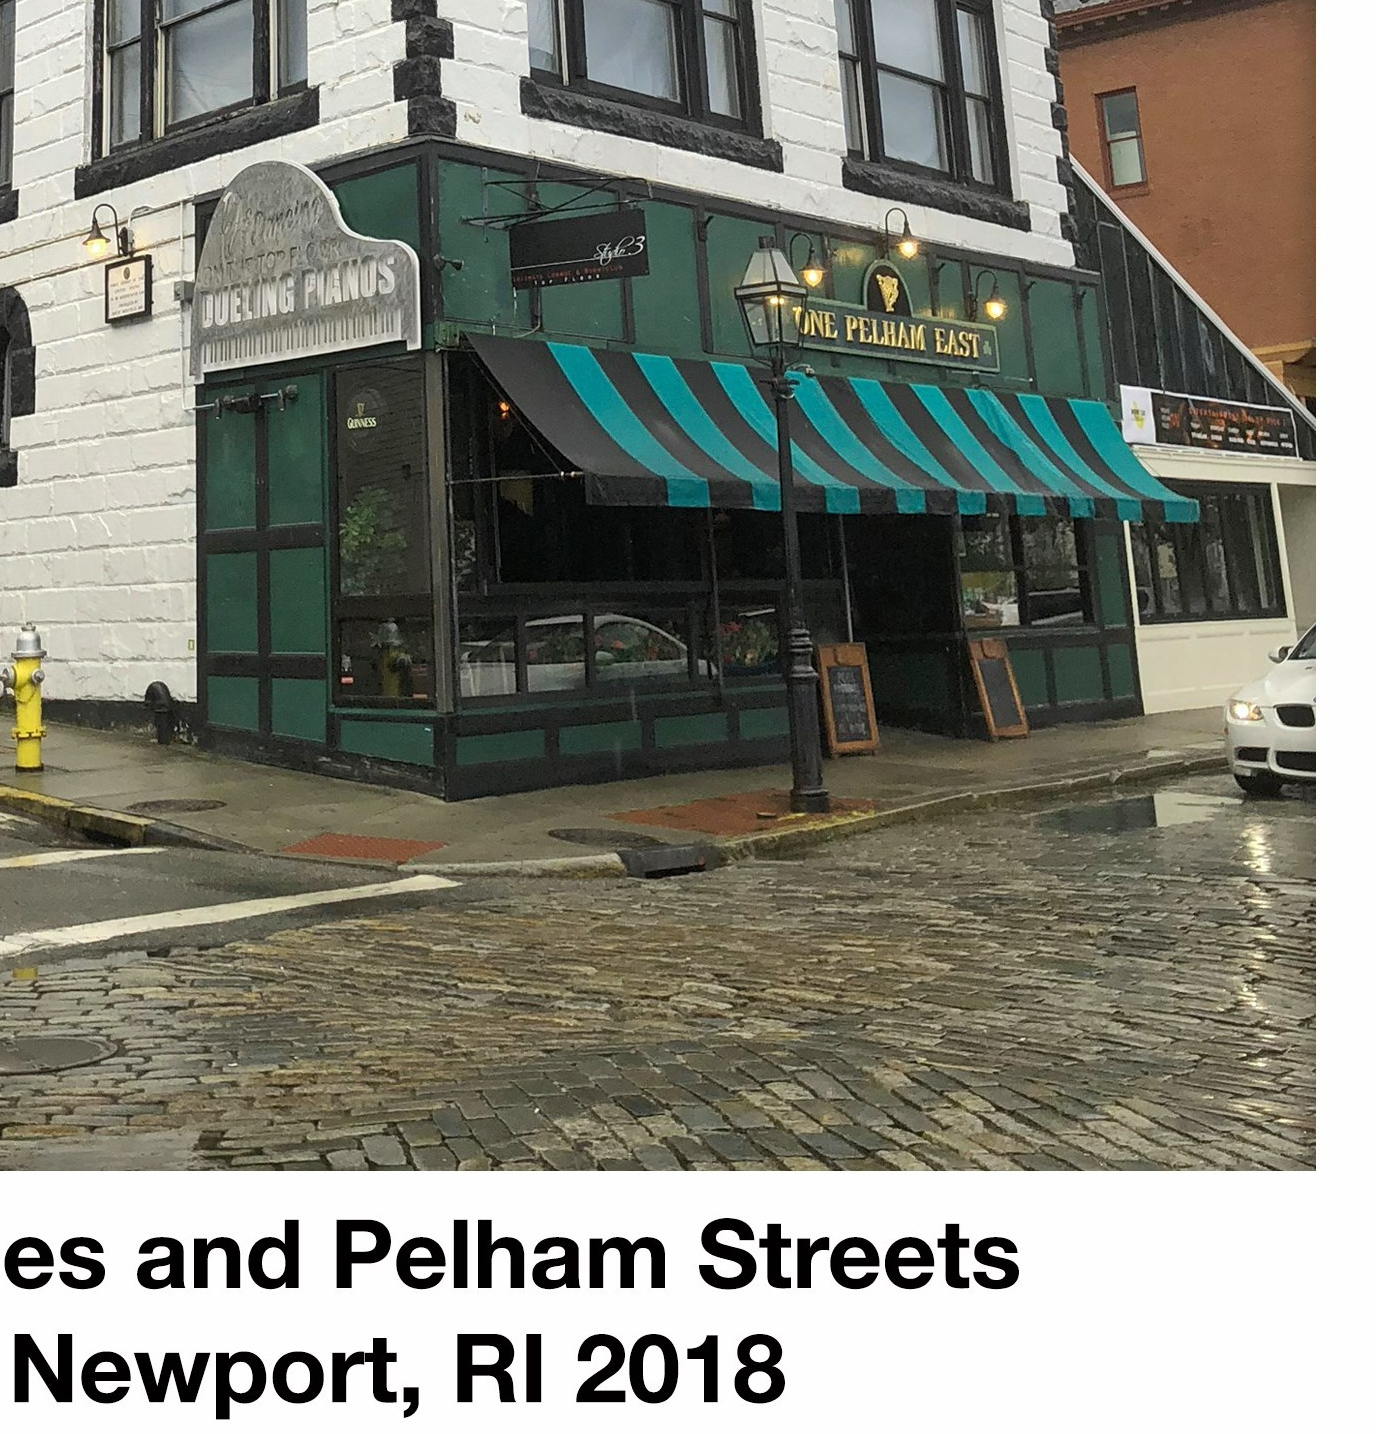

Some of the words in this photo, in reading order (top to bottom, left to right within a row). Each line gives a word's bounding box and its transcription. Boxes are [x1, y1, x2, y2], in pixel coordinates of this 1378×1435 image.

[202, 272, 295, 329] DUELING
[303, 256, 395, 311] PIANOS
[792, 306, 838, 339] ONE
[844, 314, 927, 352] PELHAM
[934, 327, 981, 359] EAST
